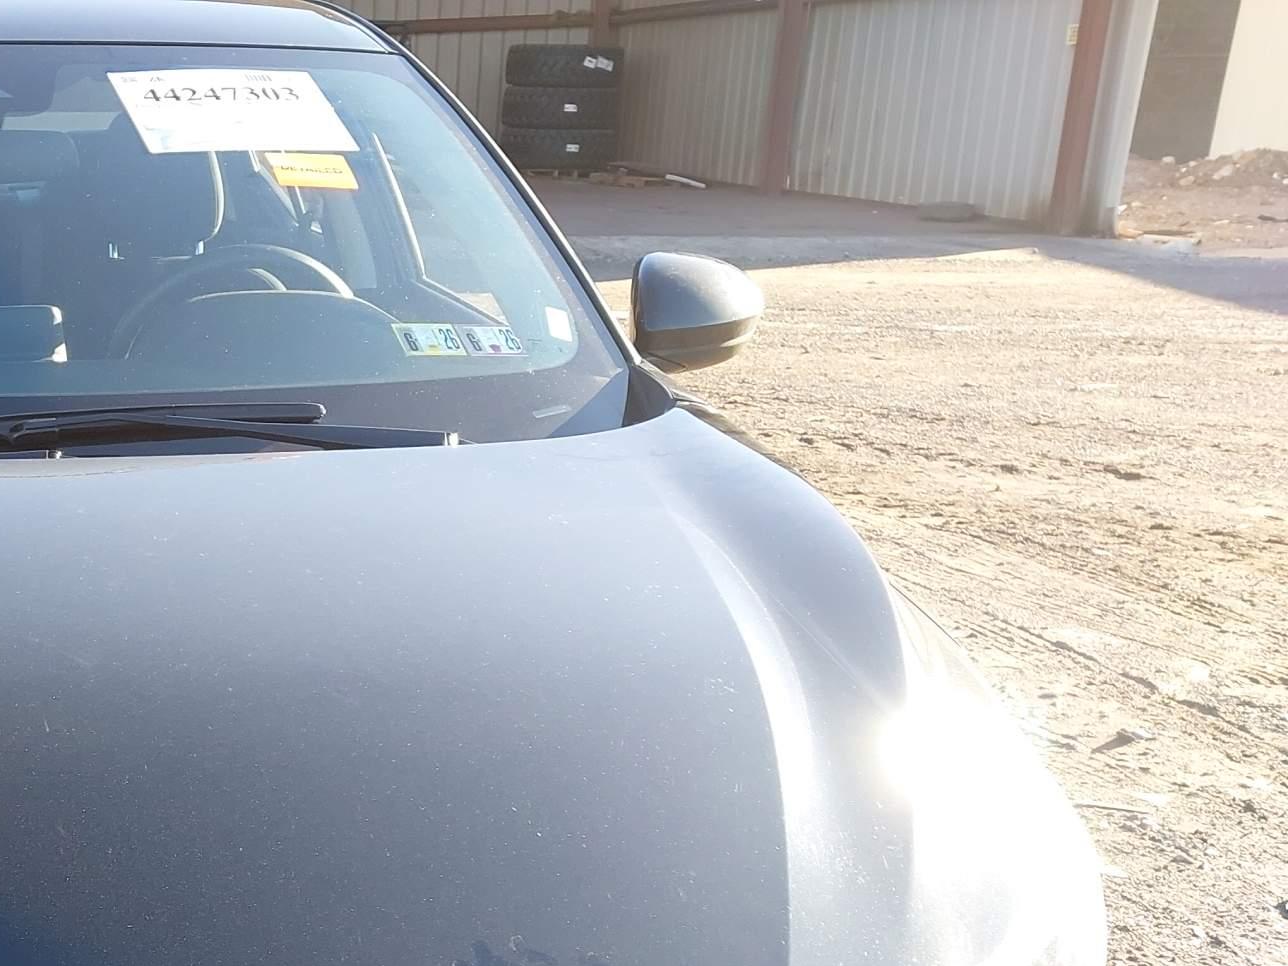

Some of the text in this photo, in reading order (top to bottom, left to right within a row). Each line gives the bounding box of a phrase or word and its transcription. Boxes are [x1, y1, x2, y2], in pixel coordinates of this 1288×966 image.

[143, 87, 300, 102] 44247303
[403, 328, 461, 352] 6 26
[466, 328, 522, 352] 6 26
